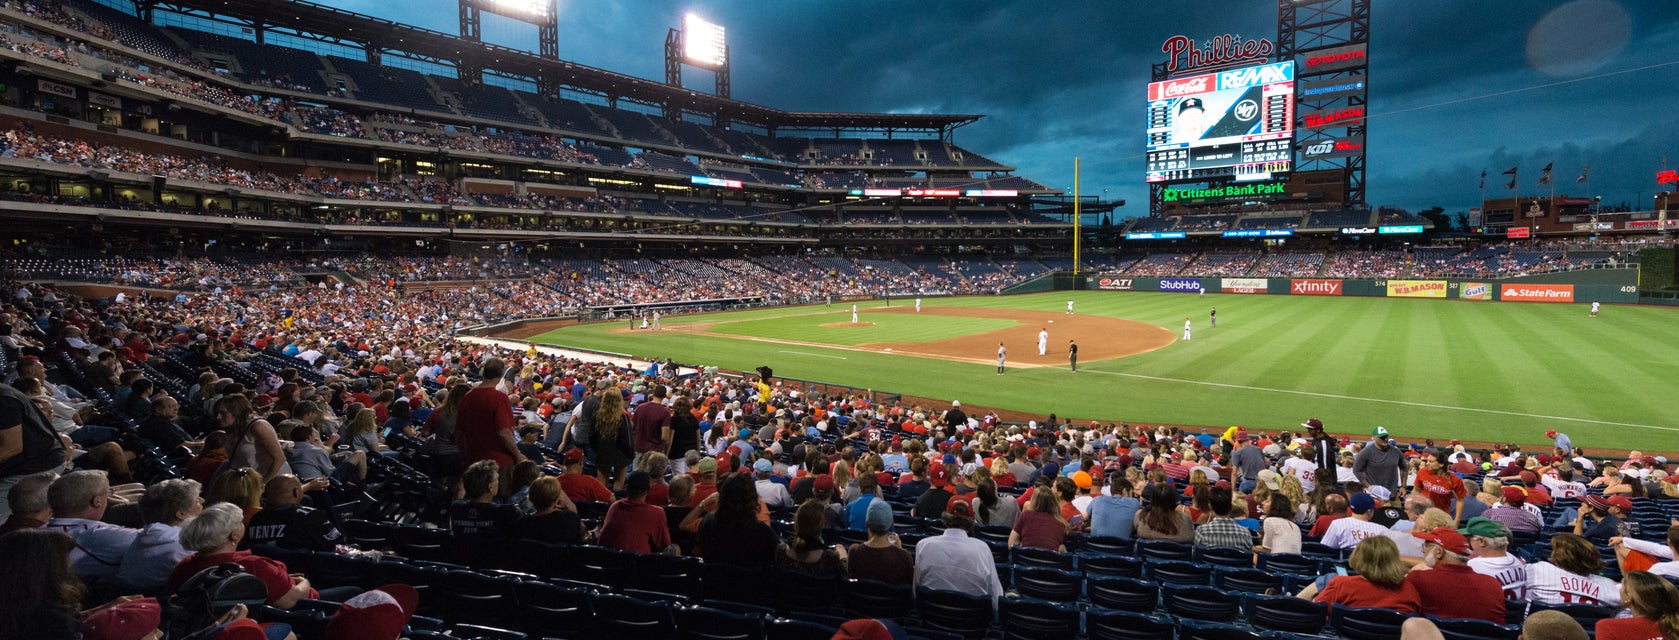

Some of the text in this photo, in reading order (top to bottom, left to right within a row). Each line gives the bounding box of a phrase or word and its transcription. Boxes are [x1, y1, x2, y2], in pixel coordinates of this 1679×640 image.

[1162, 34, 1273, 72] Phillies
[1320, 50, 1364, 64] TOYOTA
[1221, 64, 1289, 89] RE/MAX
[54, 85, 73, 95] CSN
[1180, 188, 1224, 199] Citizens
[1226, 184, 1255, 196] Bank
[1257, 182, 1285, 194] Park
[1110, 279, 1133, 287] ATI
[1160, 280, 1200, 289] StubHub
[1294, 281, 1338, 294] xfinity
[1620, 285, 1636, 293] 409
[1465, 286, 1486, 296] Gulf
[869, 432, 880, 442] 34
[1302, 470, 1315, 482] 33
[248, 524, 286, 539] WENTZ
[1560, 576, 1601, 598] BOWA
